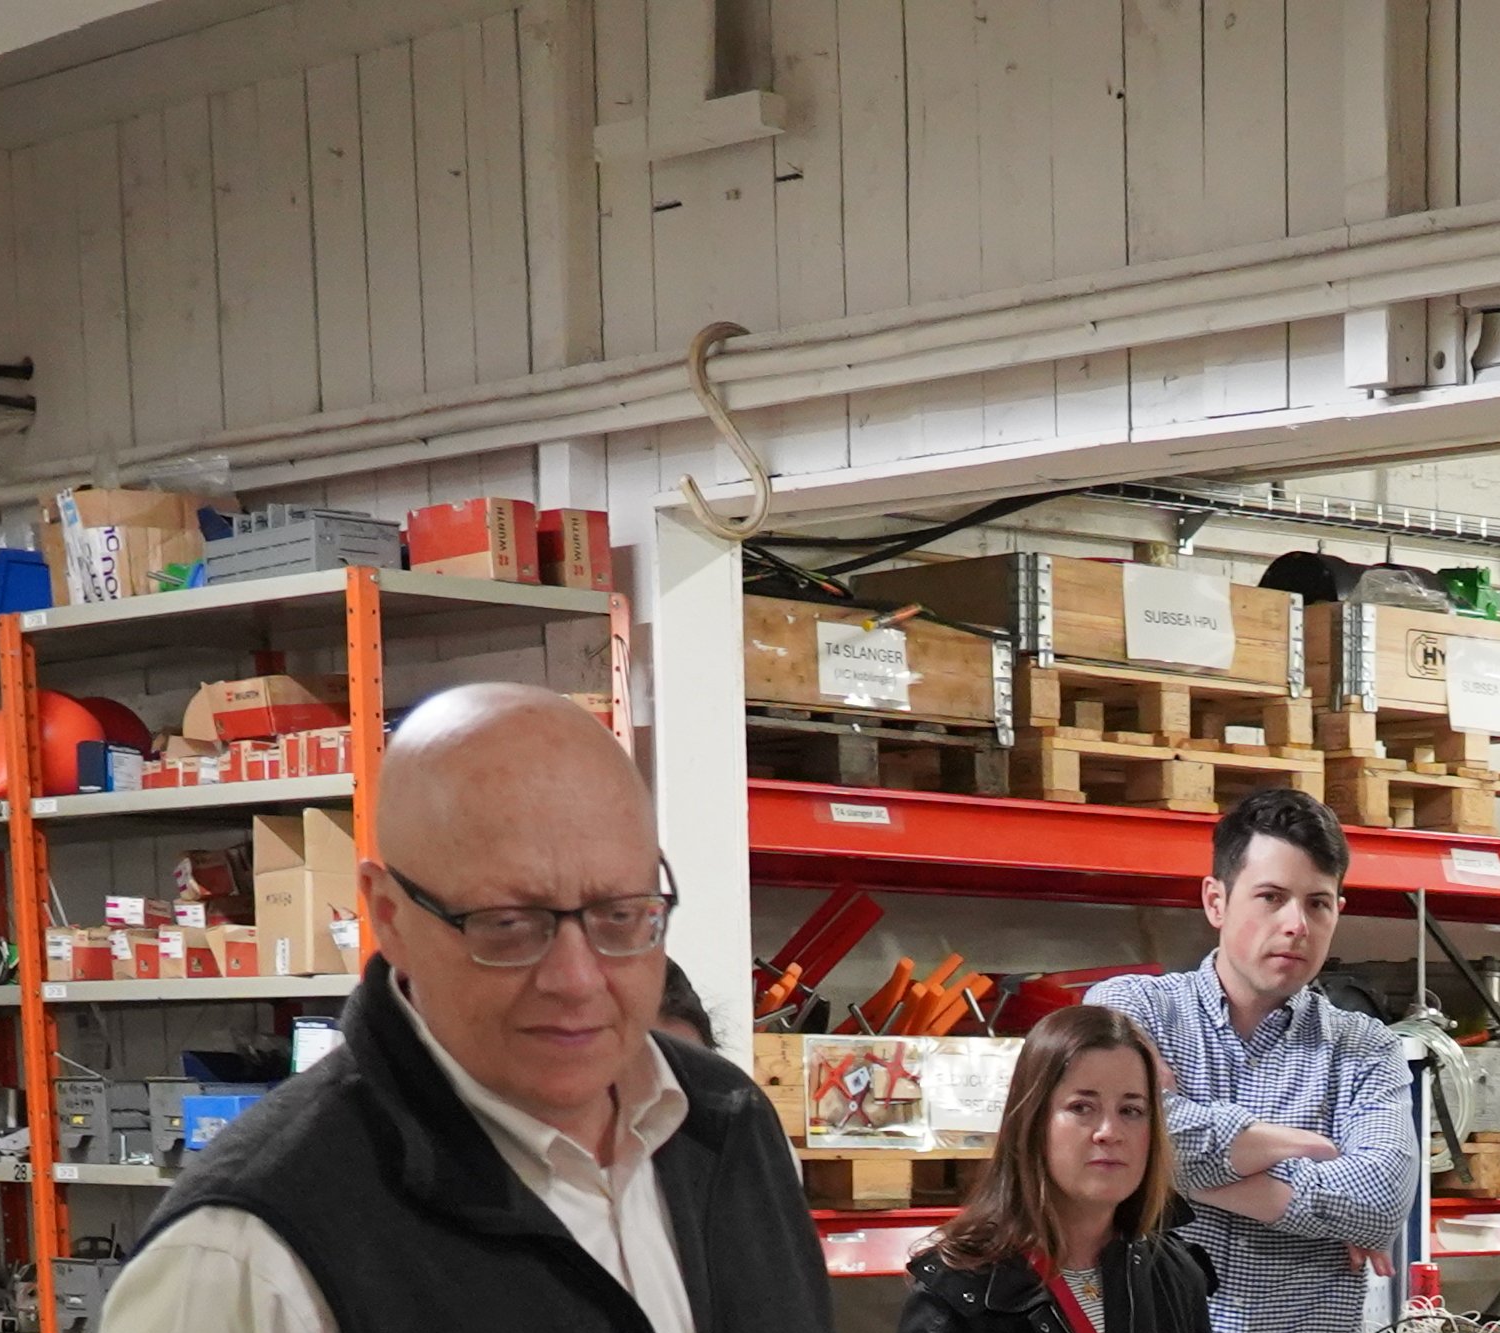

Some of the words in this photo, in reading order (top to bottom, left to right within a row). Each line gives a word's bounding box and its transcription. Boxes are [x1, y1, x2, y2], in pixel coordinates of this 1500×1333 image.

[1143, 609, 1191, 627] SUBSEA
[1194, 614, 1217, 631] HPU
[825, 642, 840, 656] T4
[843, 644, 903, 664] SLANGER
[1461, 680, 1499, 695] SUBSEA
[13, 1164, 28, 1181] 28
